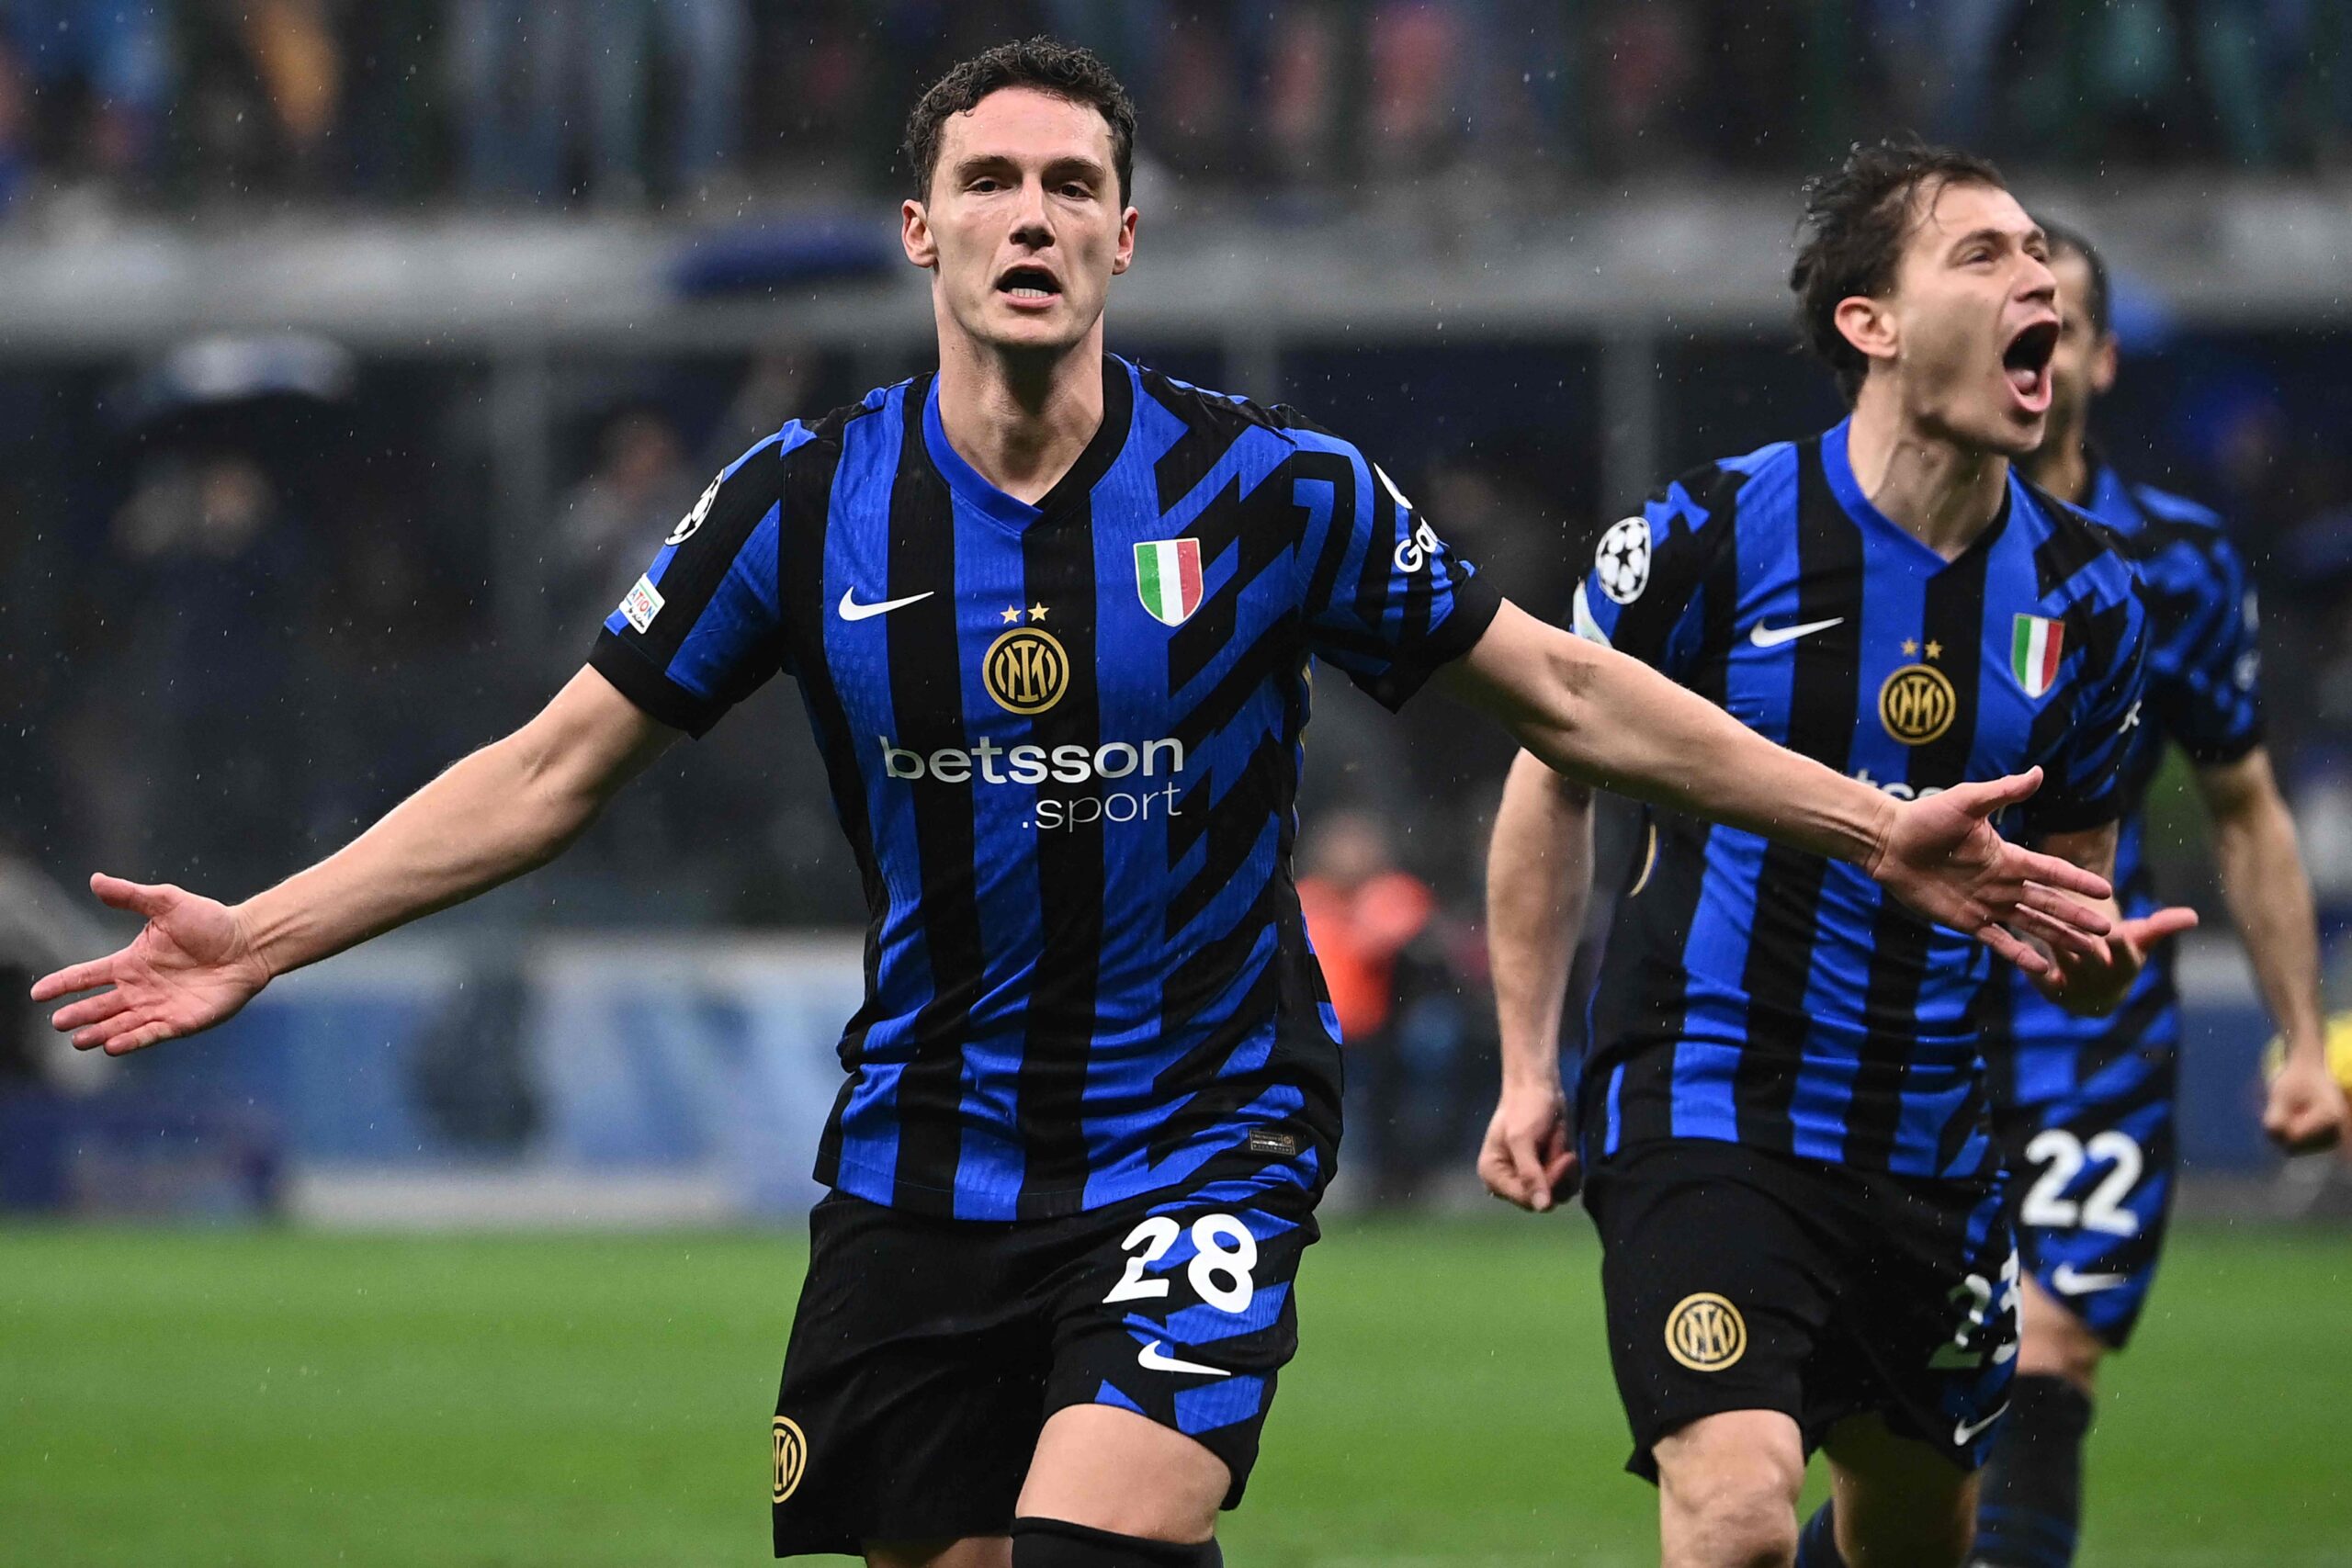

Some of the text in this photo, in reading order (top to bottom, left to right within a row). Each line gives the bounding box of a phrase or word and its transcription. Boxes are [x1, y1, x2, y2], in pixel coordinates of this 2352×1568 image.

[1395, 515, 1443, 572] Ga
[879, 736, 1183, 784] betsson
[1022, 782, 1182, 833] .sport
[2020, 1128, 2144, 1237] 22
[1102, 1213, 1258, 1314] 28
